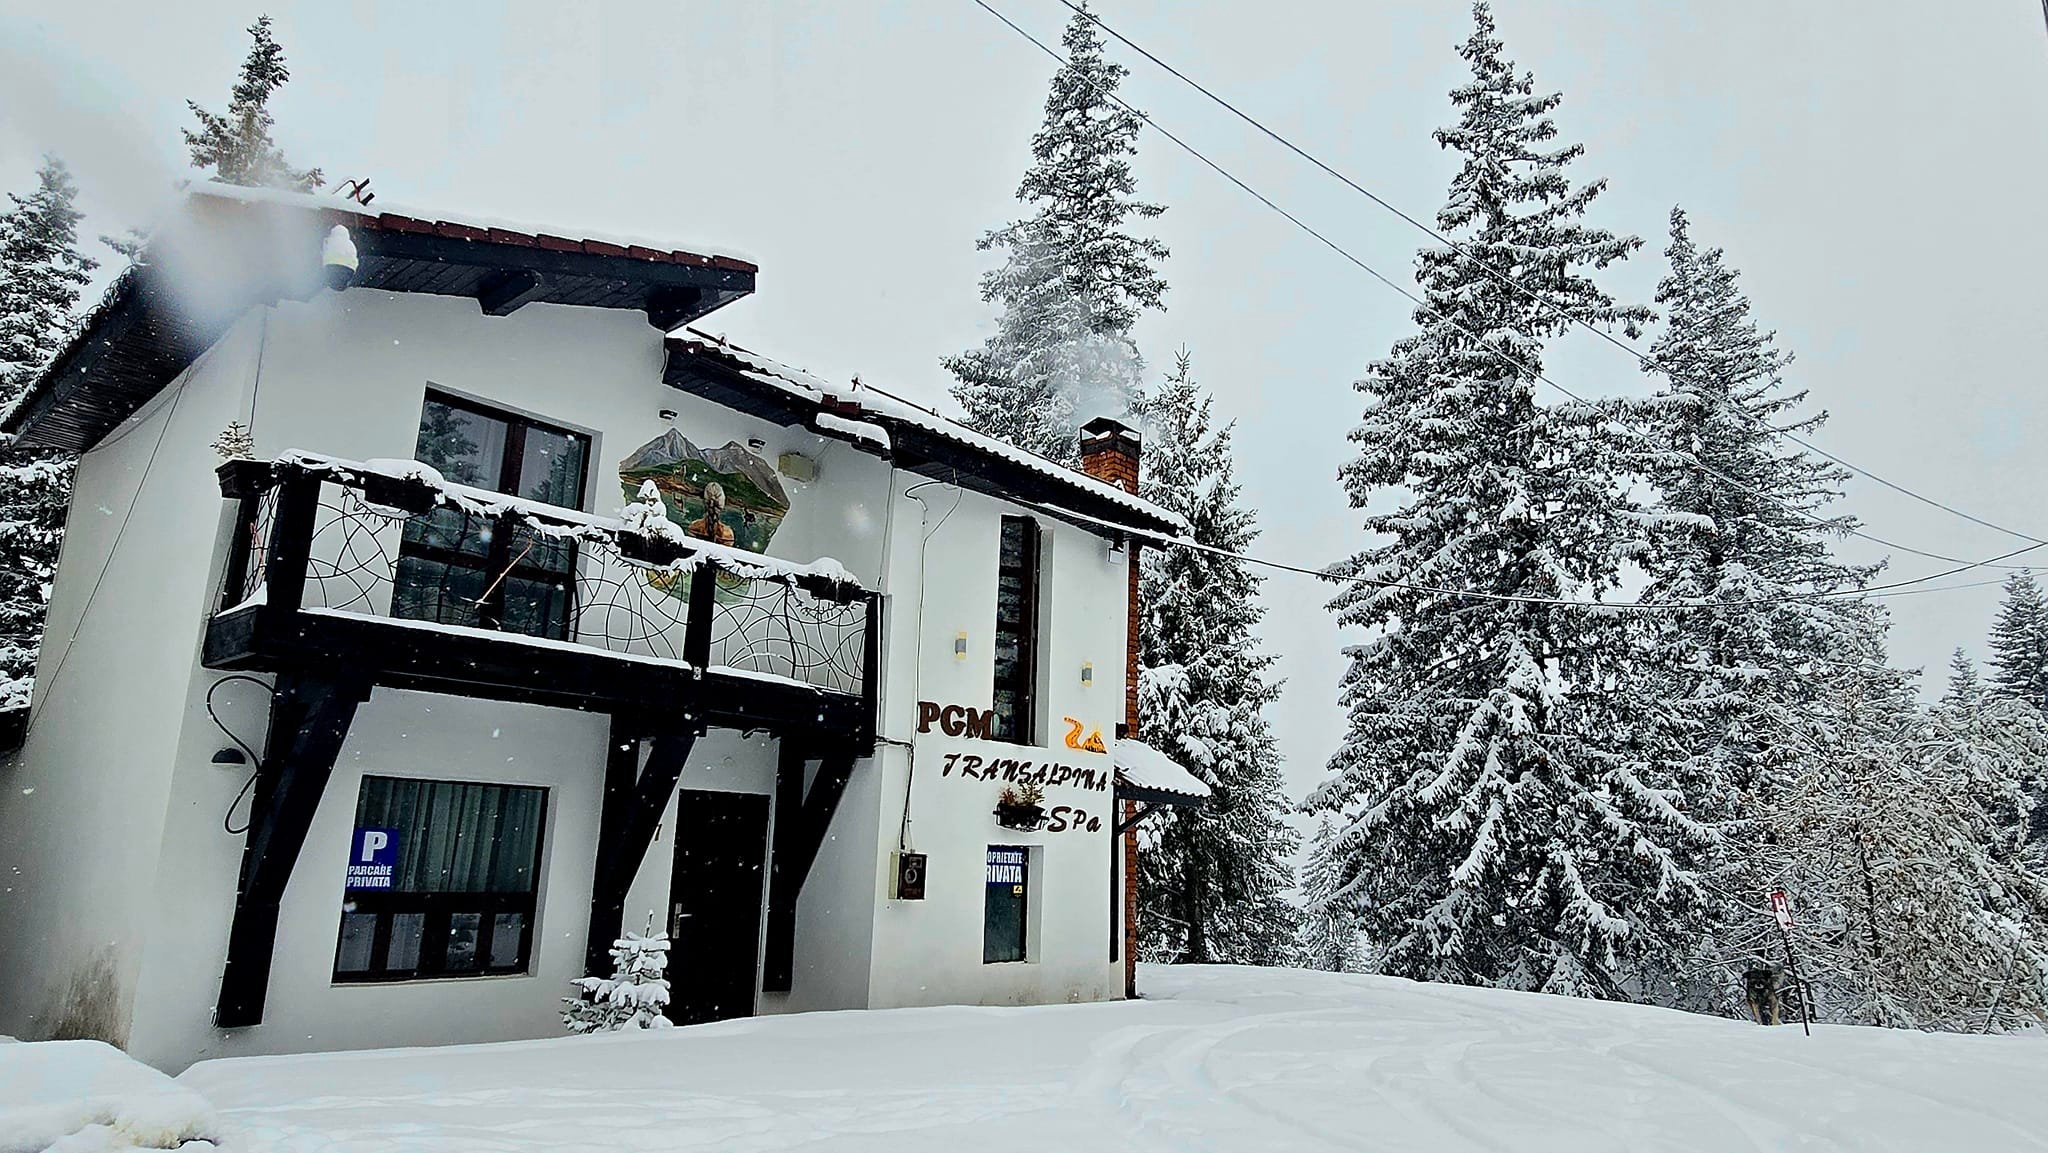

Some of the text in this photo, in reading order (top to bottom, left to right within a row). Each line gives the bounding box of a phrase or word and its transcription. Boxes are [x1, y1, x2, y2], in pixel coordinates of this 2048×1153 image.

[918, 702, 993, 740] PGM
[943, 753, 1107, 791] TRANSALPINA
[362, 831, 388, 861] P
[347, 877, 390, 887] PRIVATA
[348, 865, 393, 876] PARCARE
